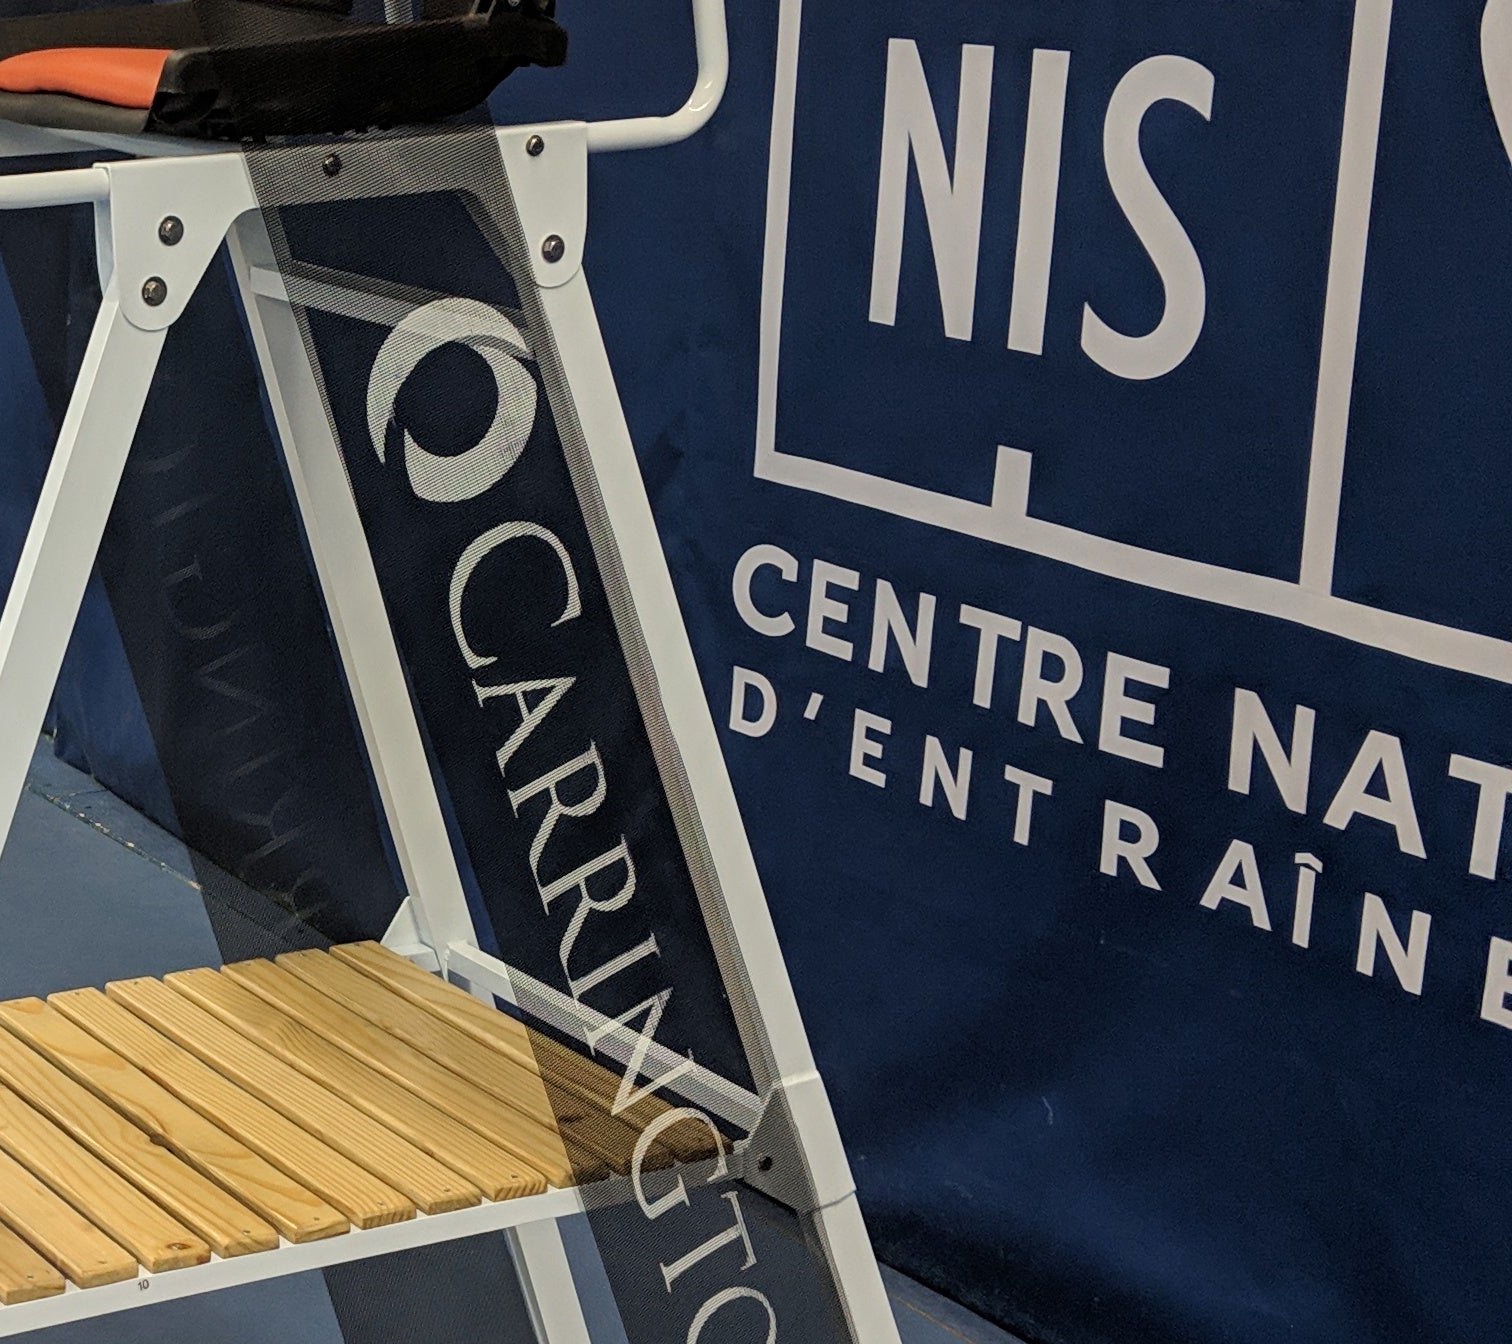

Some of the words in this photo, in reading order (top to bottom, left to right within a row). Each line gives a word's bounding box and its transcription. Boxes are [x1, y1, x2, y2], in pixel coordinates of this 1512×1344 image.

[868, 37, 1215, 380] NIS
[732, 544, 1170, 767] CENTRE
[1228, 688, 1512, 880] NAT
[138, 1279, 150, 1291] 10
